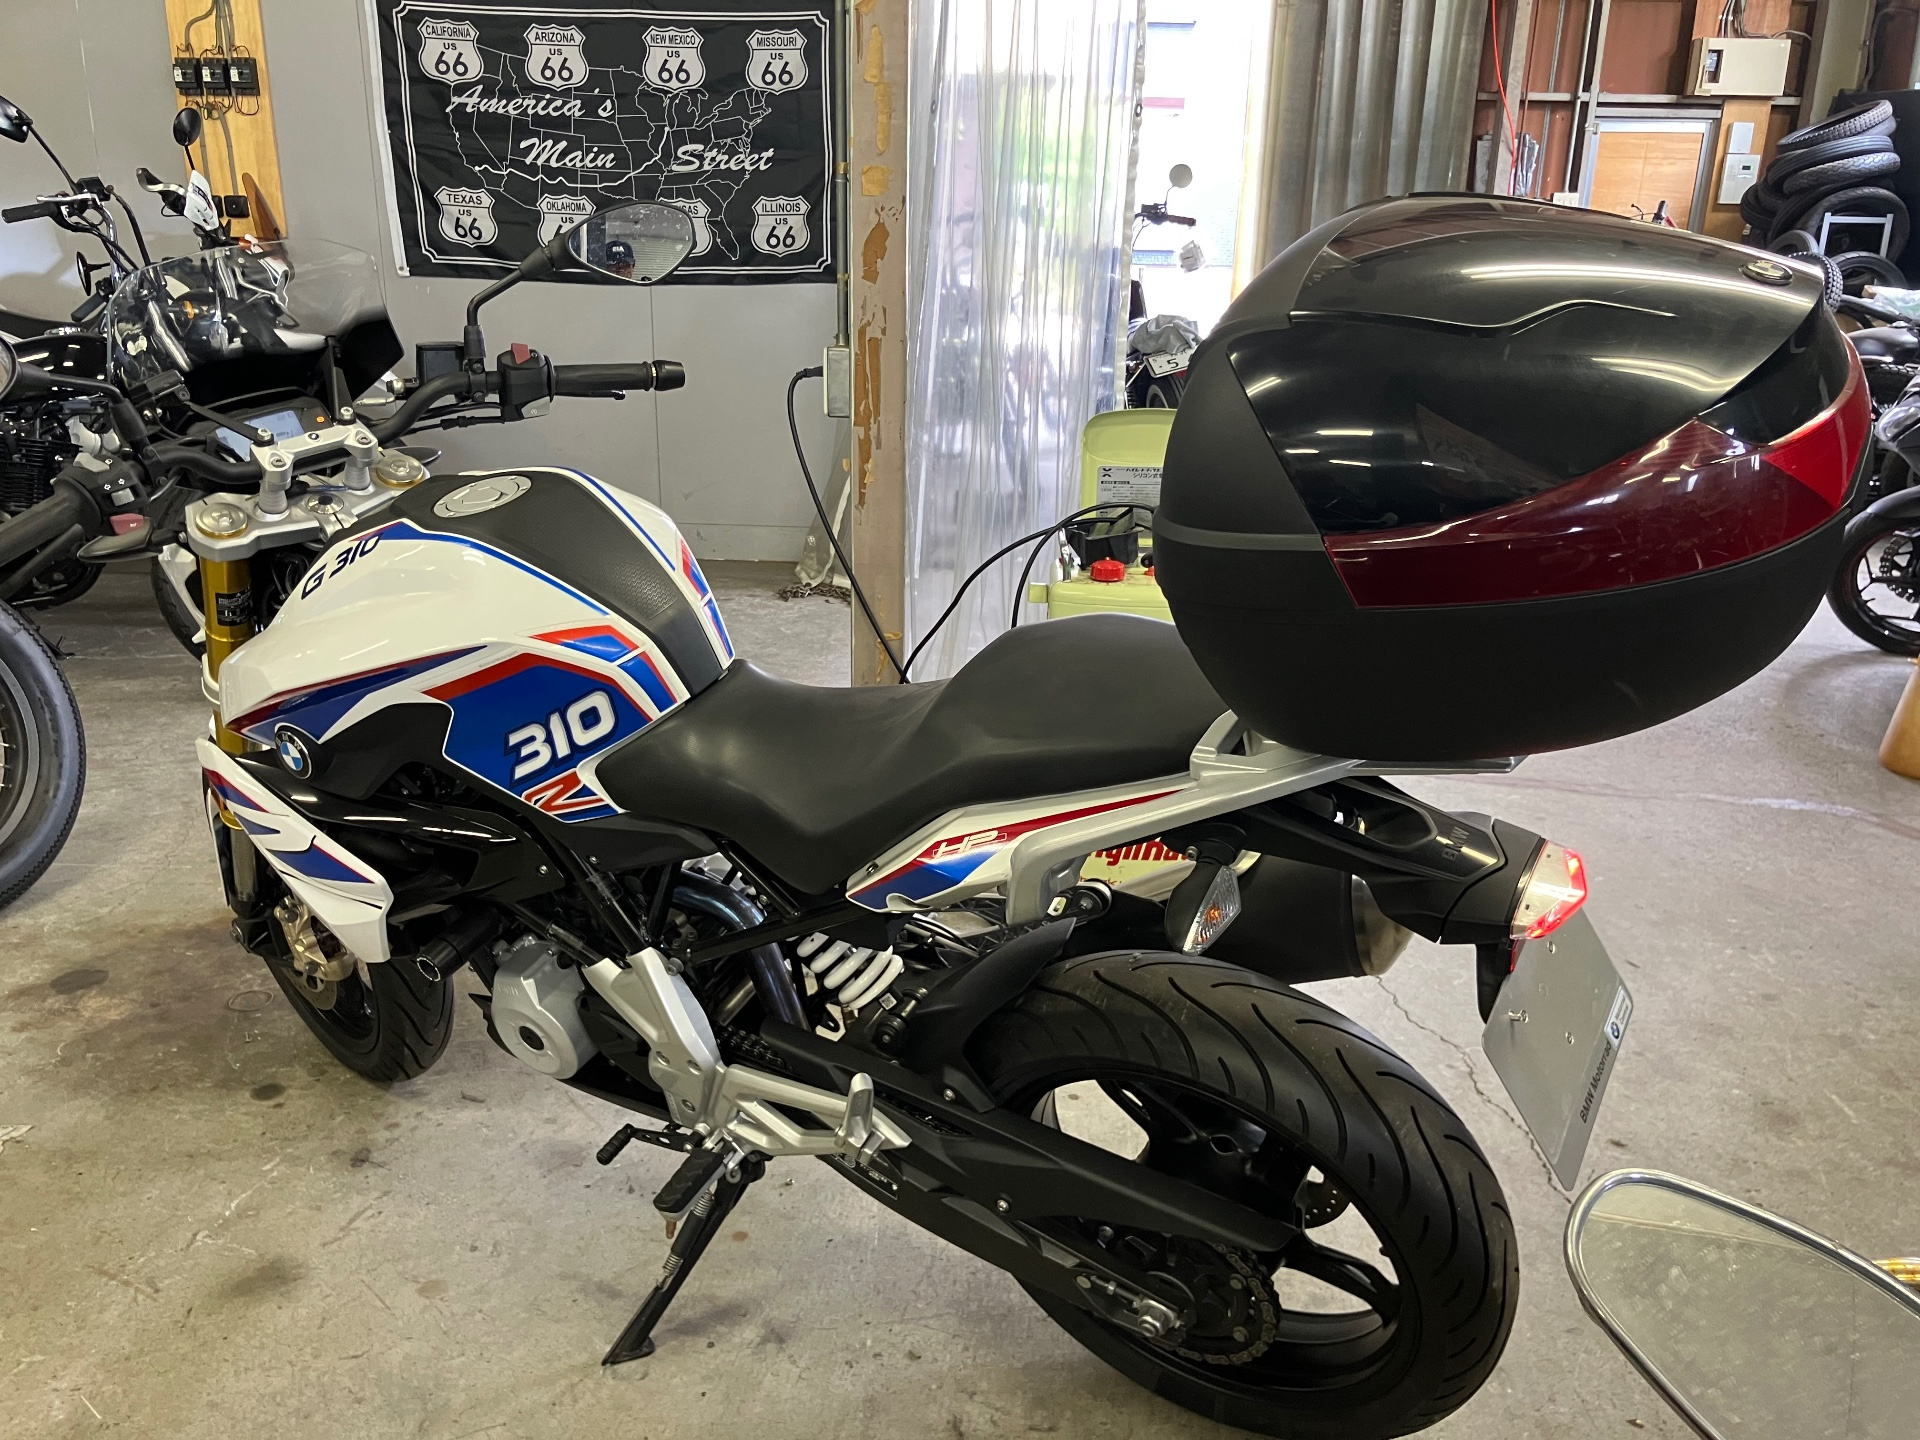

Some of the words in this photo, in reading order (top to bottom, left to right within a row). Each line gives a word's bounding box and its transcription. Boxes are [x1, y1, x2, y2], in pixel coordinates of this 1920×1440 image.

[425, 24, 472, 39] CALIFORNIA
[534, 31, 576, 44] ARIZONA
[443, 42, 457, 51] US
[650, 33, 667, 45] NEW
[668, 34, 696, 46] MEXICO
[756, 36, 797, 47] MISSOURI
[549, 48, 563, 56] US
[666, 50, 681, 58] US
[770, 52, 784, 60] US
[434, 51, 469, 77] 66
[540, 56, 574, 82] 66
[657, 58, 691, 85] 66
[761, 61, 794, 87] 66
[445, 83, 616, 118] America's
[520, 136, 616, 169] Main
[671, 143, 775, 172] Street
[446, 193, 483, 205] TEXAS
[458, 208, 472, 217] US
[546, 201, 587, 212] OKLAHOMA
[761, 202, 801, 213] ILLINOIS
[561, 216, 575, 224] US
[775, 217, 789, 225] US
[454, 216, 483, 241] 66
[766, 225, 796, 249] 66
[301, 562, 328, 600] G
[329, 532, 384, 579] 310
[506, 689, 617, 784] 310
[933, 830, 1000, 859] HP
[1579, 1087, 1596, 1124] BMW
[1590, 1038, 1613, 1092] Motorrad
